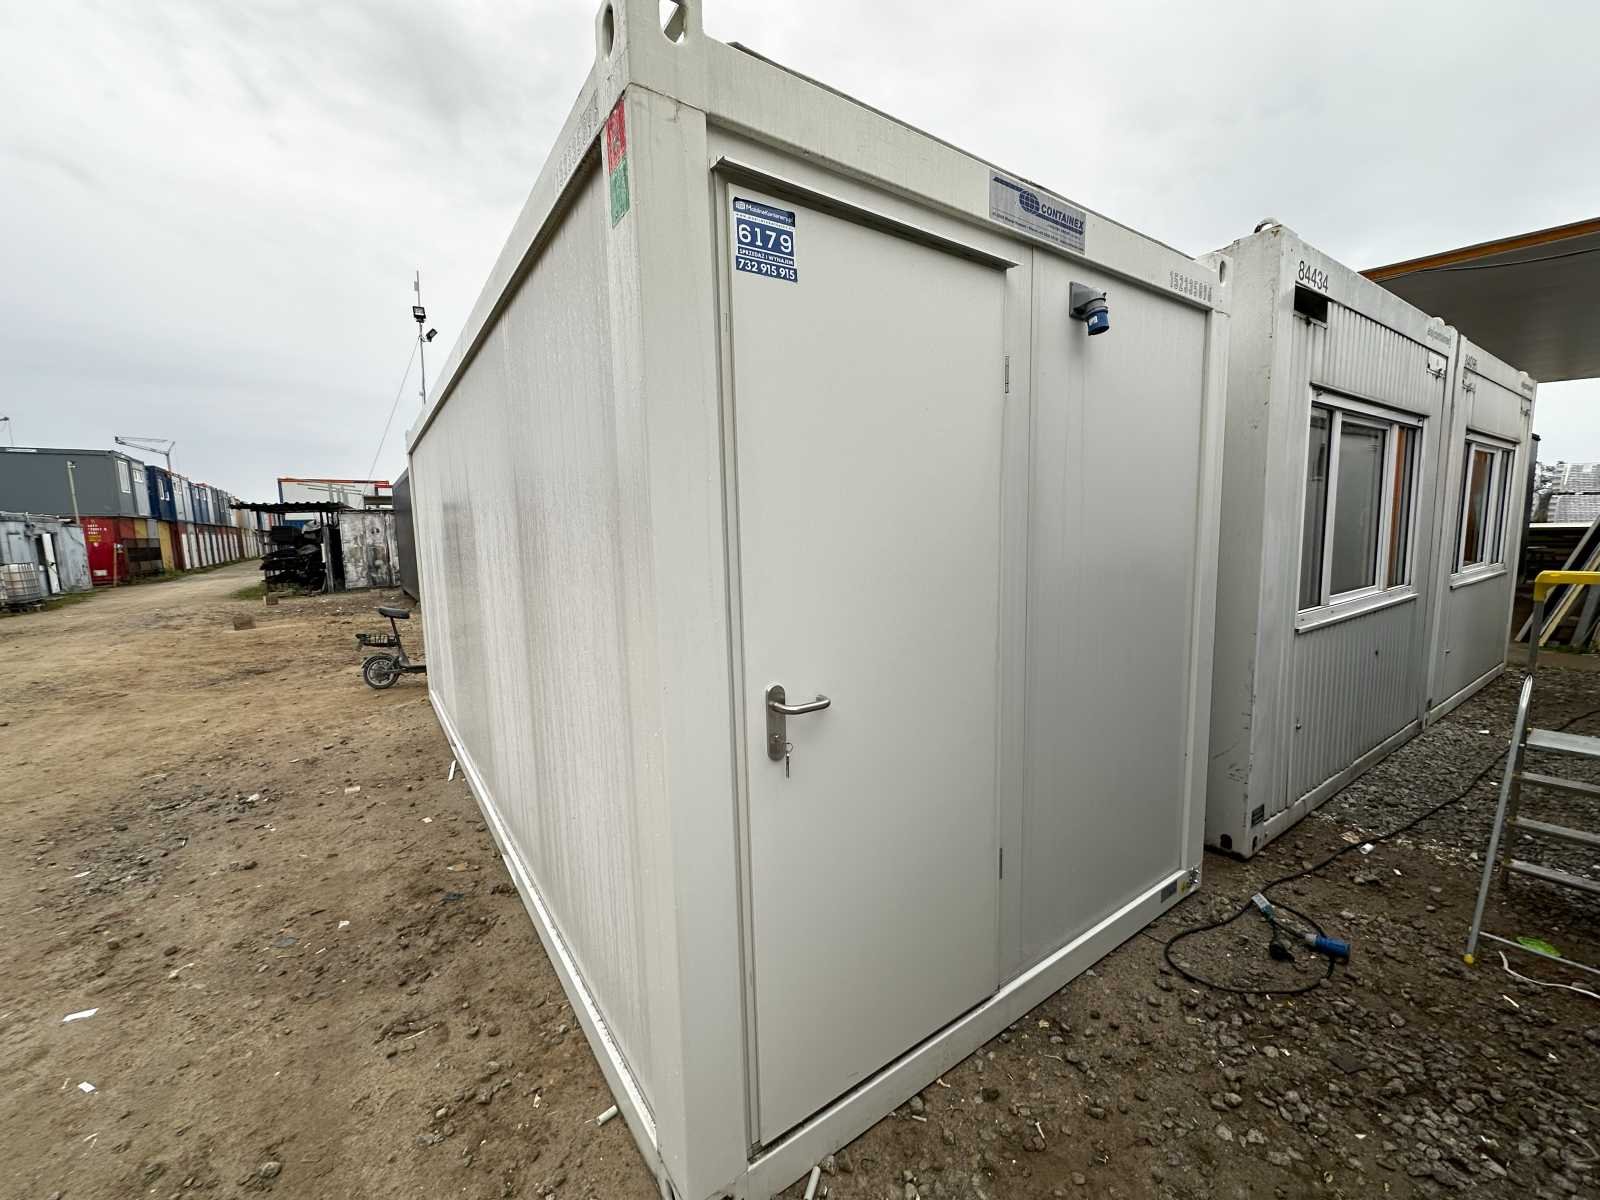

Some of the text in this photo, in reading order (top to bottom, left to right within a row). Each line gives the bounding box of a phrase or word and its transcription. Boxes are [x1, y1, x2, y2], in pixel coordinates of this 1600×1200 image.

[1041, 203, 1084, 229] CONTAINEX
[738, 223, 792, 253] 6179
[738, 258, 796, 280] 732 915 915
[1298, 260, 1329, 294] 84434
